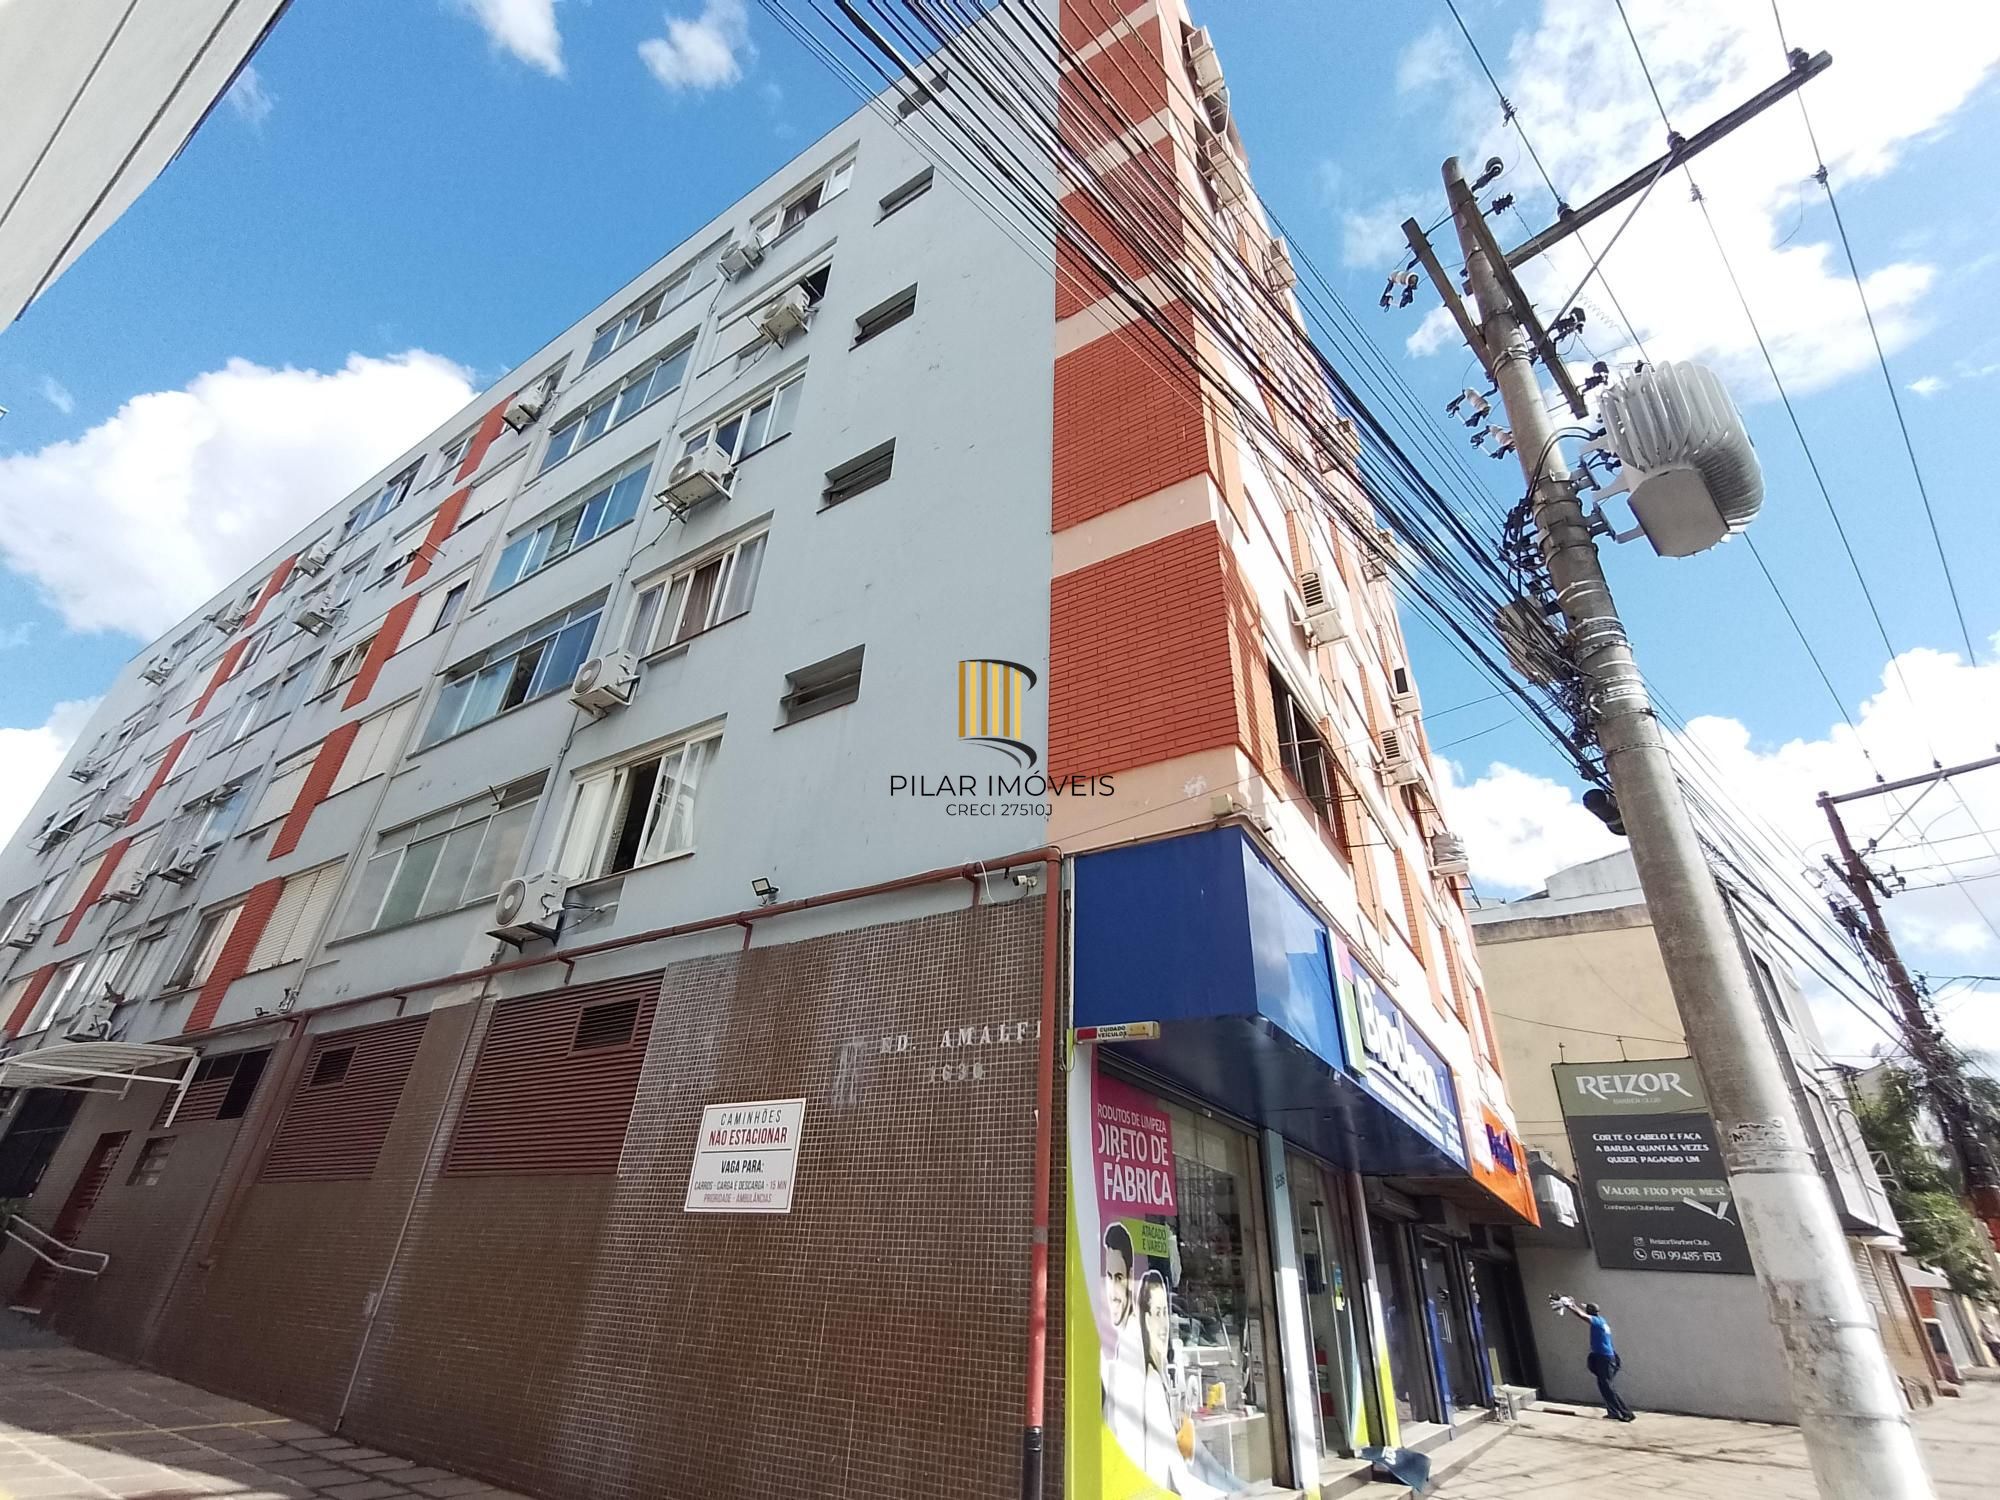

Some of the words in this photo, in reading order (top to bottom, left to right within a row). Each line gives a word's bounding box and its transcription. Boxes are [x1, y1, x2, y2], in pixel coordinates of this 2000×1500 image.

[1575, 1072, 1693, 1100] REIZOR
[720, 1108, 782, 1126] CAMINHÕES
[1131, 1112, 1141, 1127] DE
[1140, 1113, 1167, 1134] LIMPEZA
[728, 1126, 788, 1145] ESTACIONAR
[1150, 1134, 1169, 1166] DE
[1636, 1144, 1679, 1152] QUANTAS
[1680, 1143, 1710, 1151] VEZES
[720, 1160, 740, 1173] VAGA
[1685, 1155, 1701, 1163] UM
[1103, 1154, 1174, 1206] FÁBRICA
[1602, 1186, 1640, 1196] VALOR
[1643, 1187, 1669, 1196] FIXO
[1671, 1186, 1696, 1196] POR
